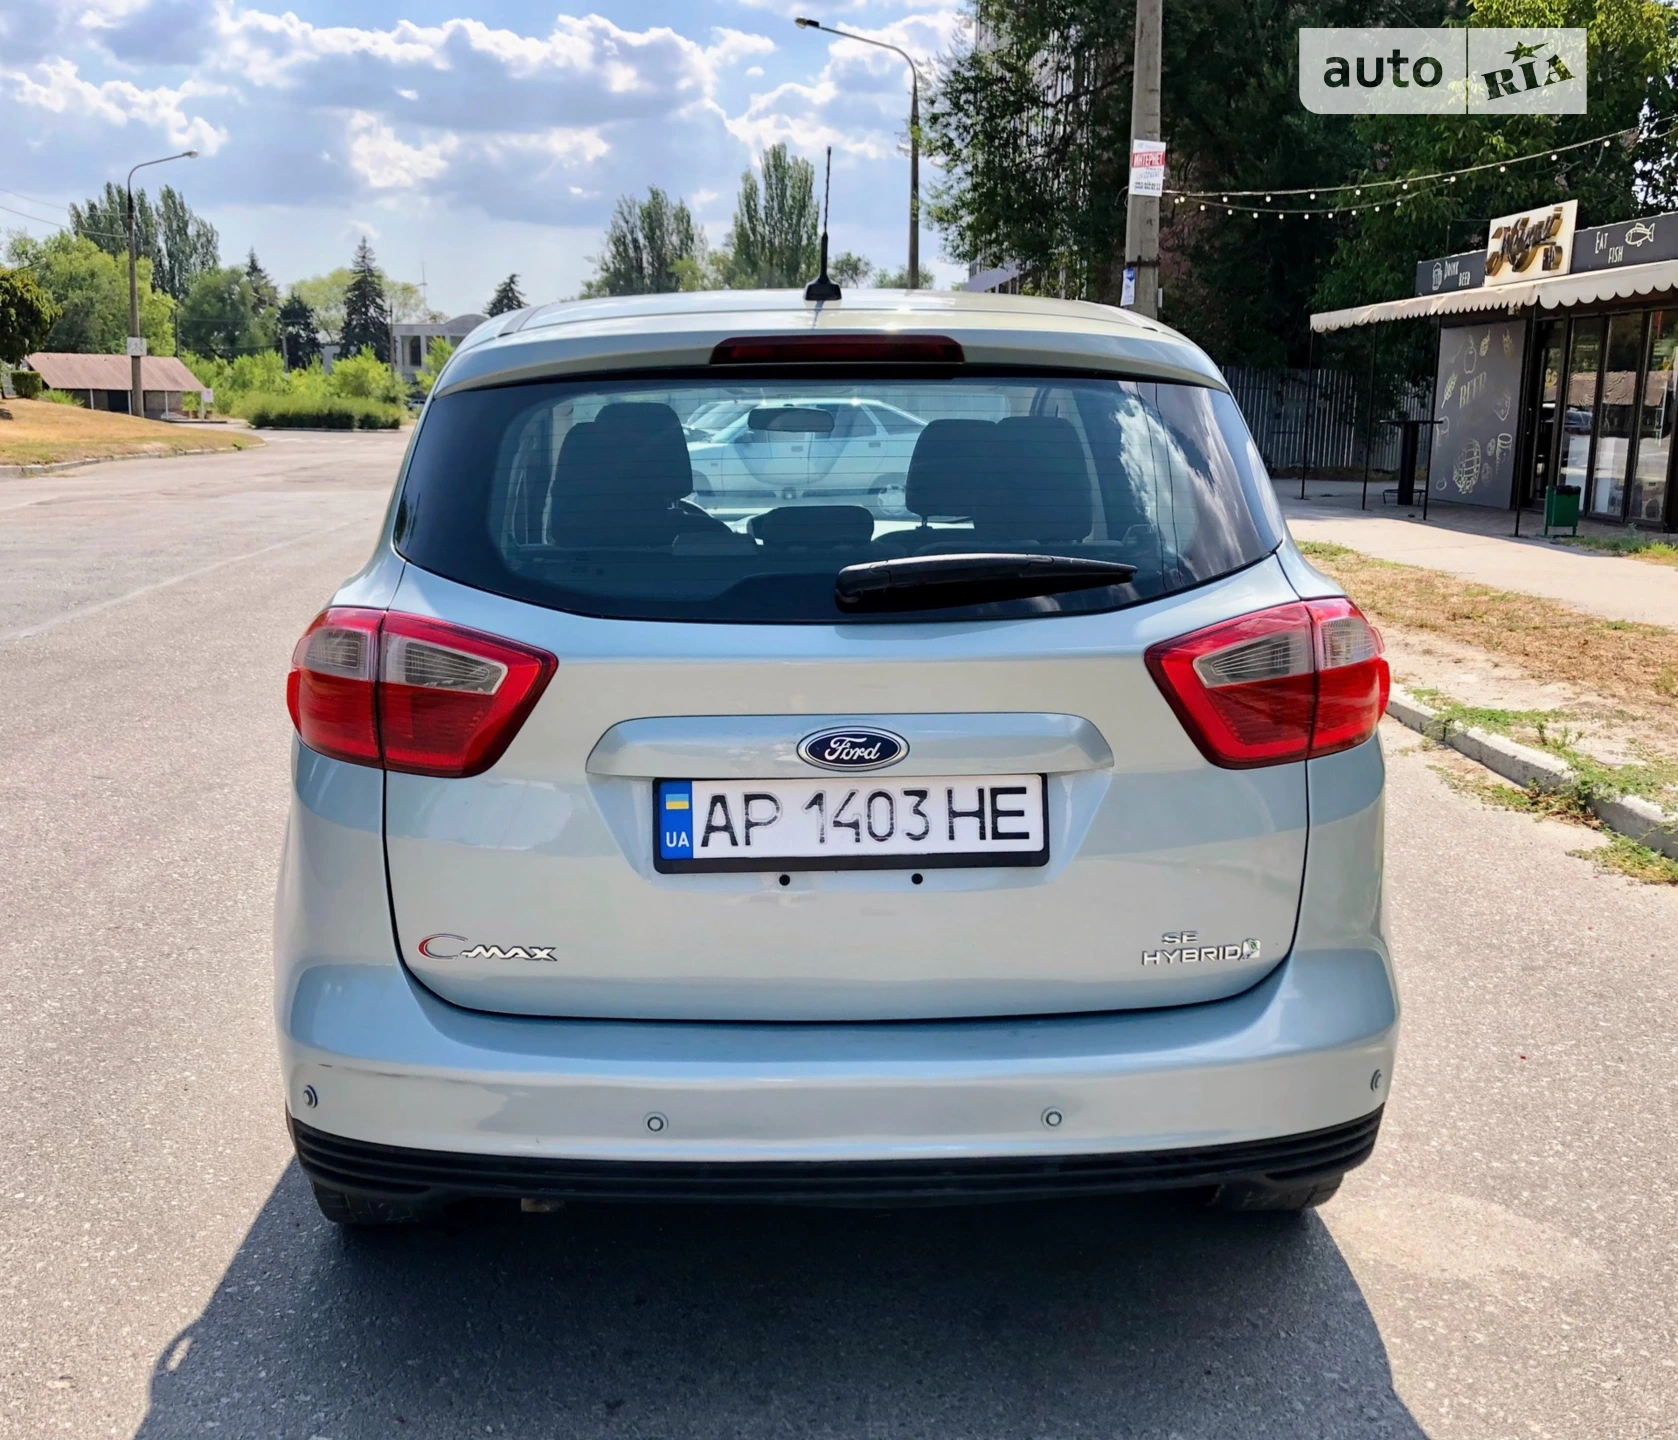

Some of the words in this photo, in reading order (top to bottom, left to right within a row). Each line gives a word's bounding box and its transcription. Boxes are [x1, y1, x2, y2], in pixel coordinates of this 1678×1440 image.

[1134, 152, 1164, 167] ИНТЕРНЕТ
[1608, 245, 1624, 264] FISH
[1458, 271, 1471, 287] BEER
[824, 736, 882, 762] Ford
[700, 791, 782, 848] AP
[803, 788, 931, 844] 1403
[947, 786, 1030, 842] HE
[666, 832, 690, 849] UA
[1162, 930, 1199, 945] SE
[1141, 944, 1243, 966] HYBRID
